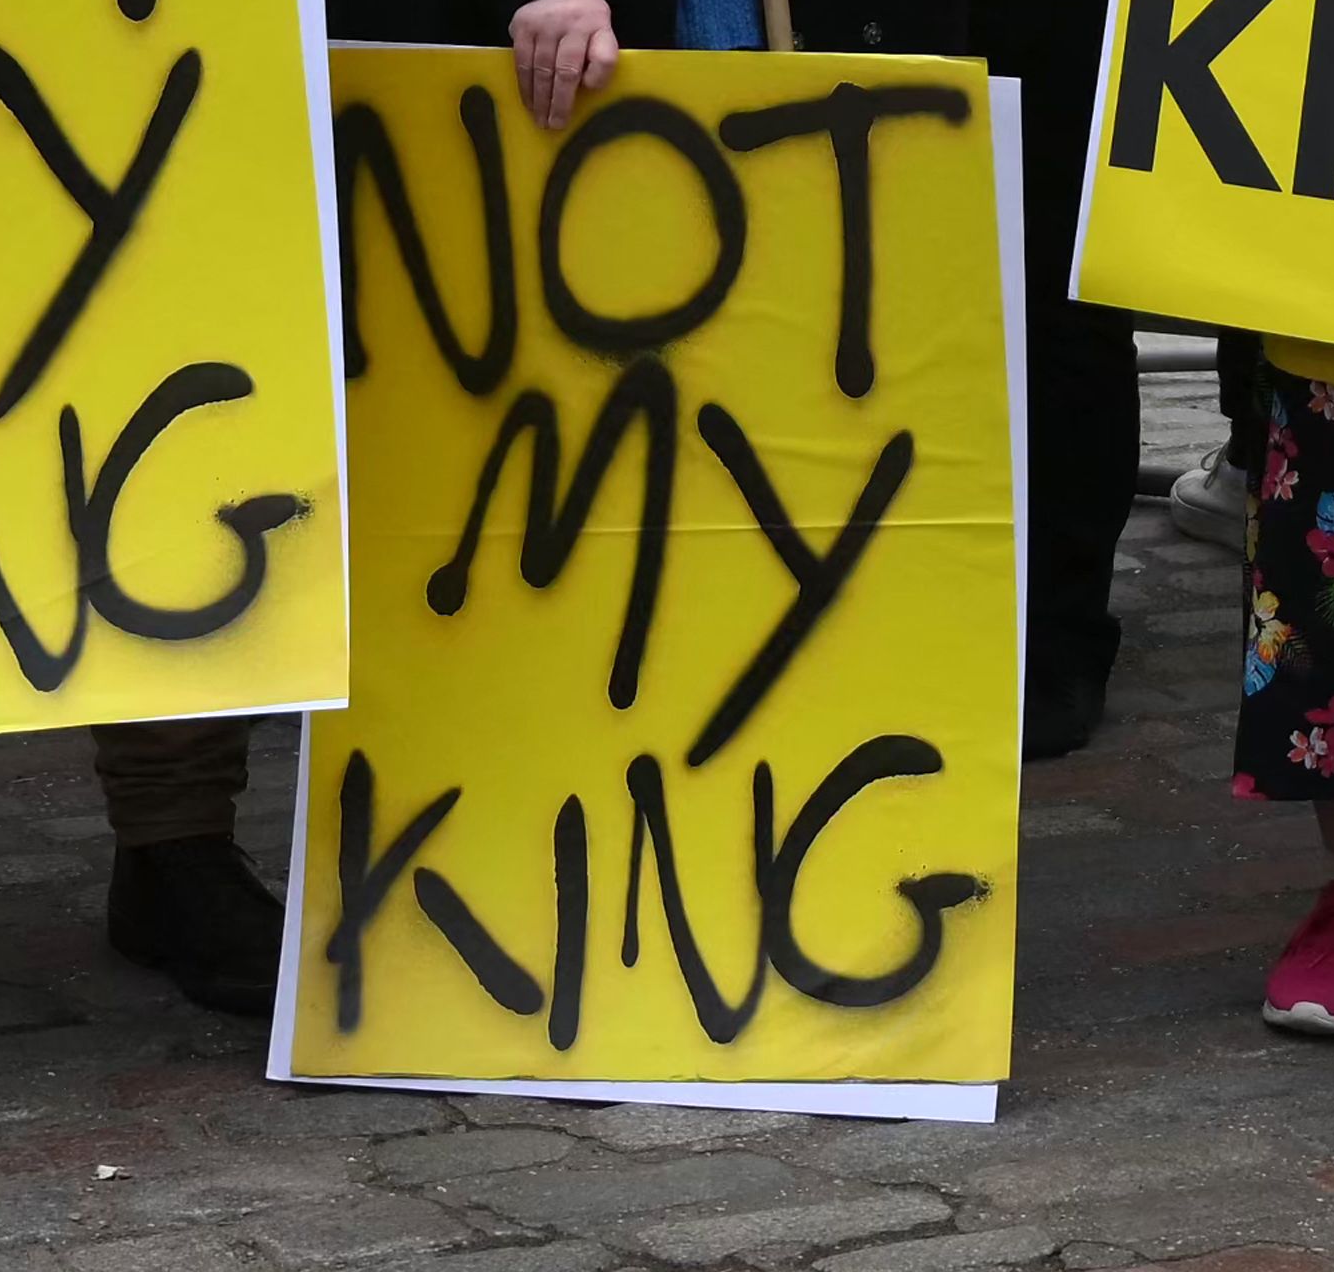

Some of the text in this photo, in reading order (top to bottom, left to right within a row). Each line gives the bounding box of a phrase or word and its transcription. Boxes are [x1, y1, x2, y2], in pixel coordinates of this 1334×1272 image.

[333, 81, 970, 399] NOT
[426, 353, 914, 768] MY
[326, 734, 989, 1051] KING
